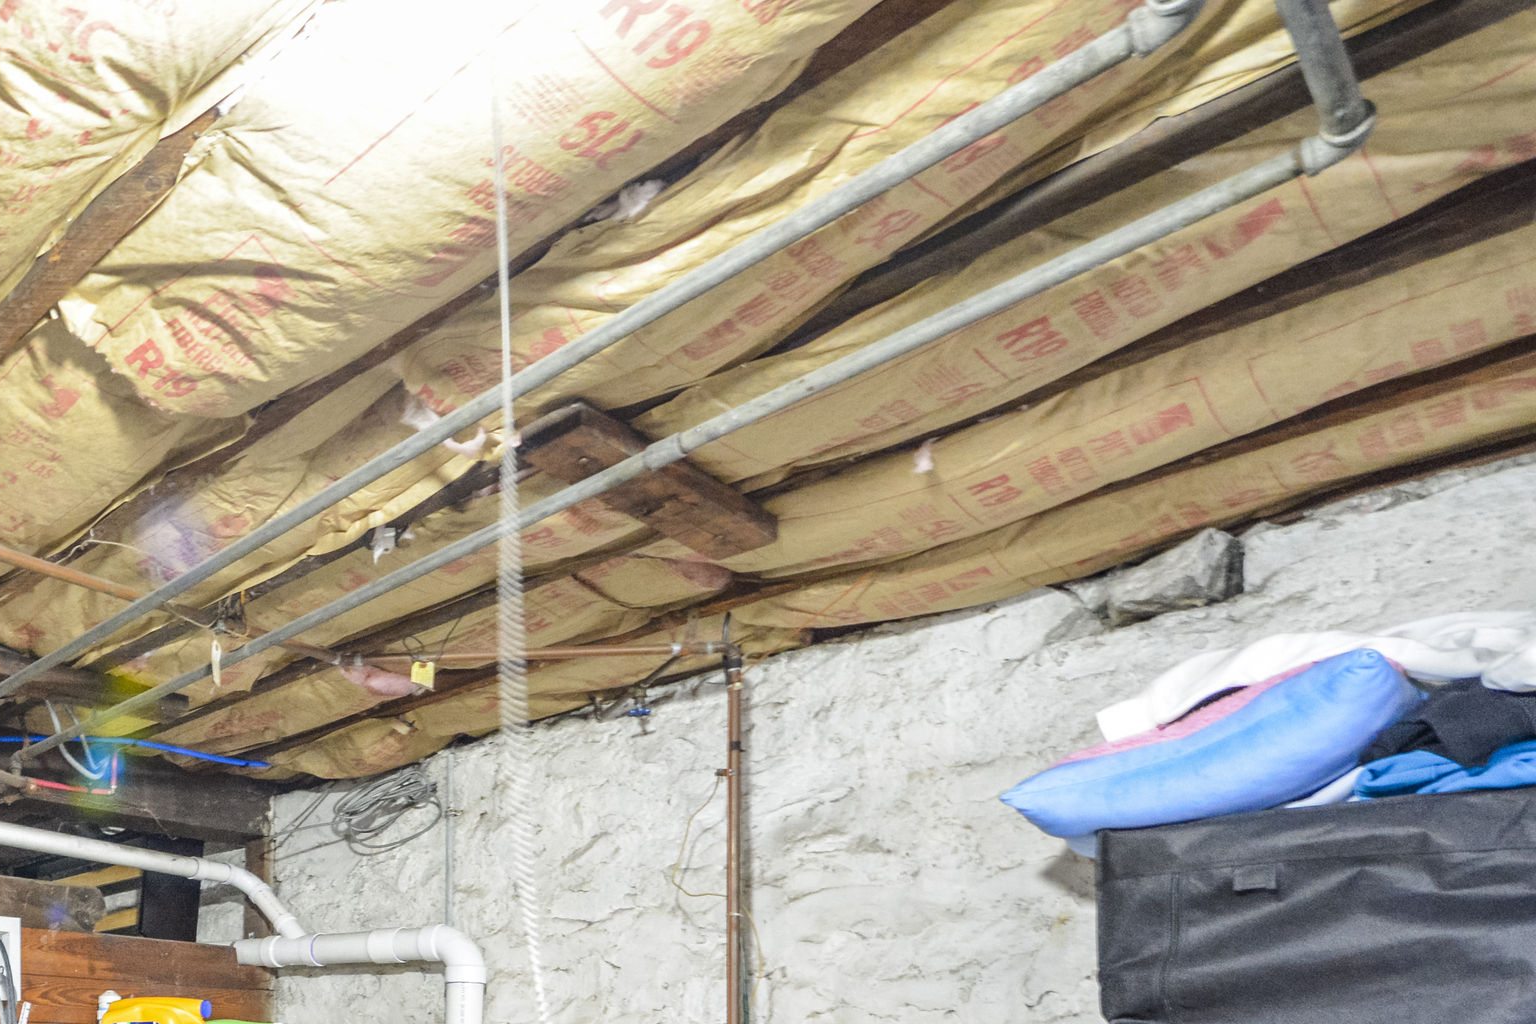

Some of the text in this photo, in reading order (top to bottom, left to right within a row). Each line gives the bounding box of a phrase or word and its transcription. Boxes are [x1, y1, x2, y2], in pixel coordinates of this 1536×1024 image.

[996, 316, 1069, 362] R19
[124, 338, 199, 398] R19
[965, 473, 1024, 507] R19
